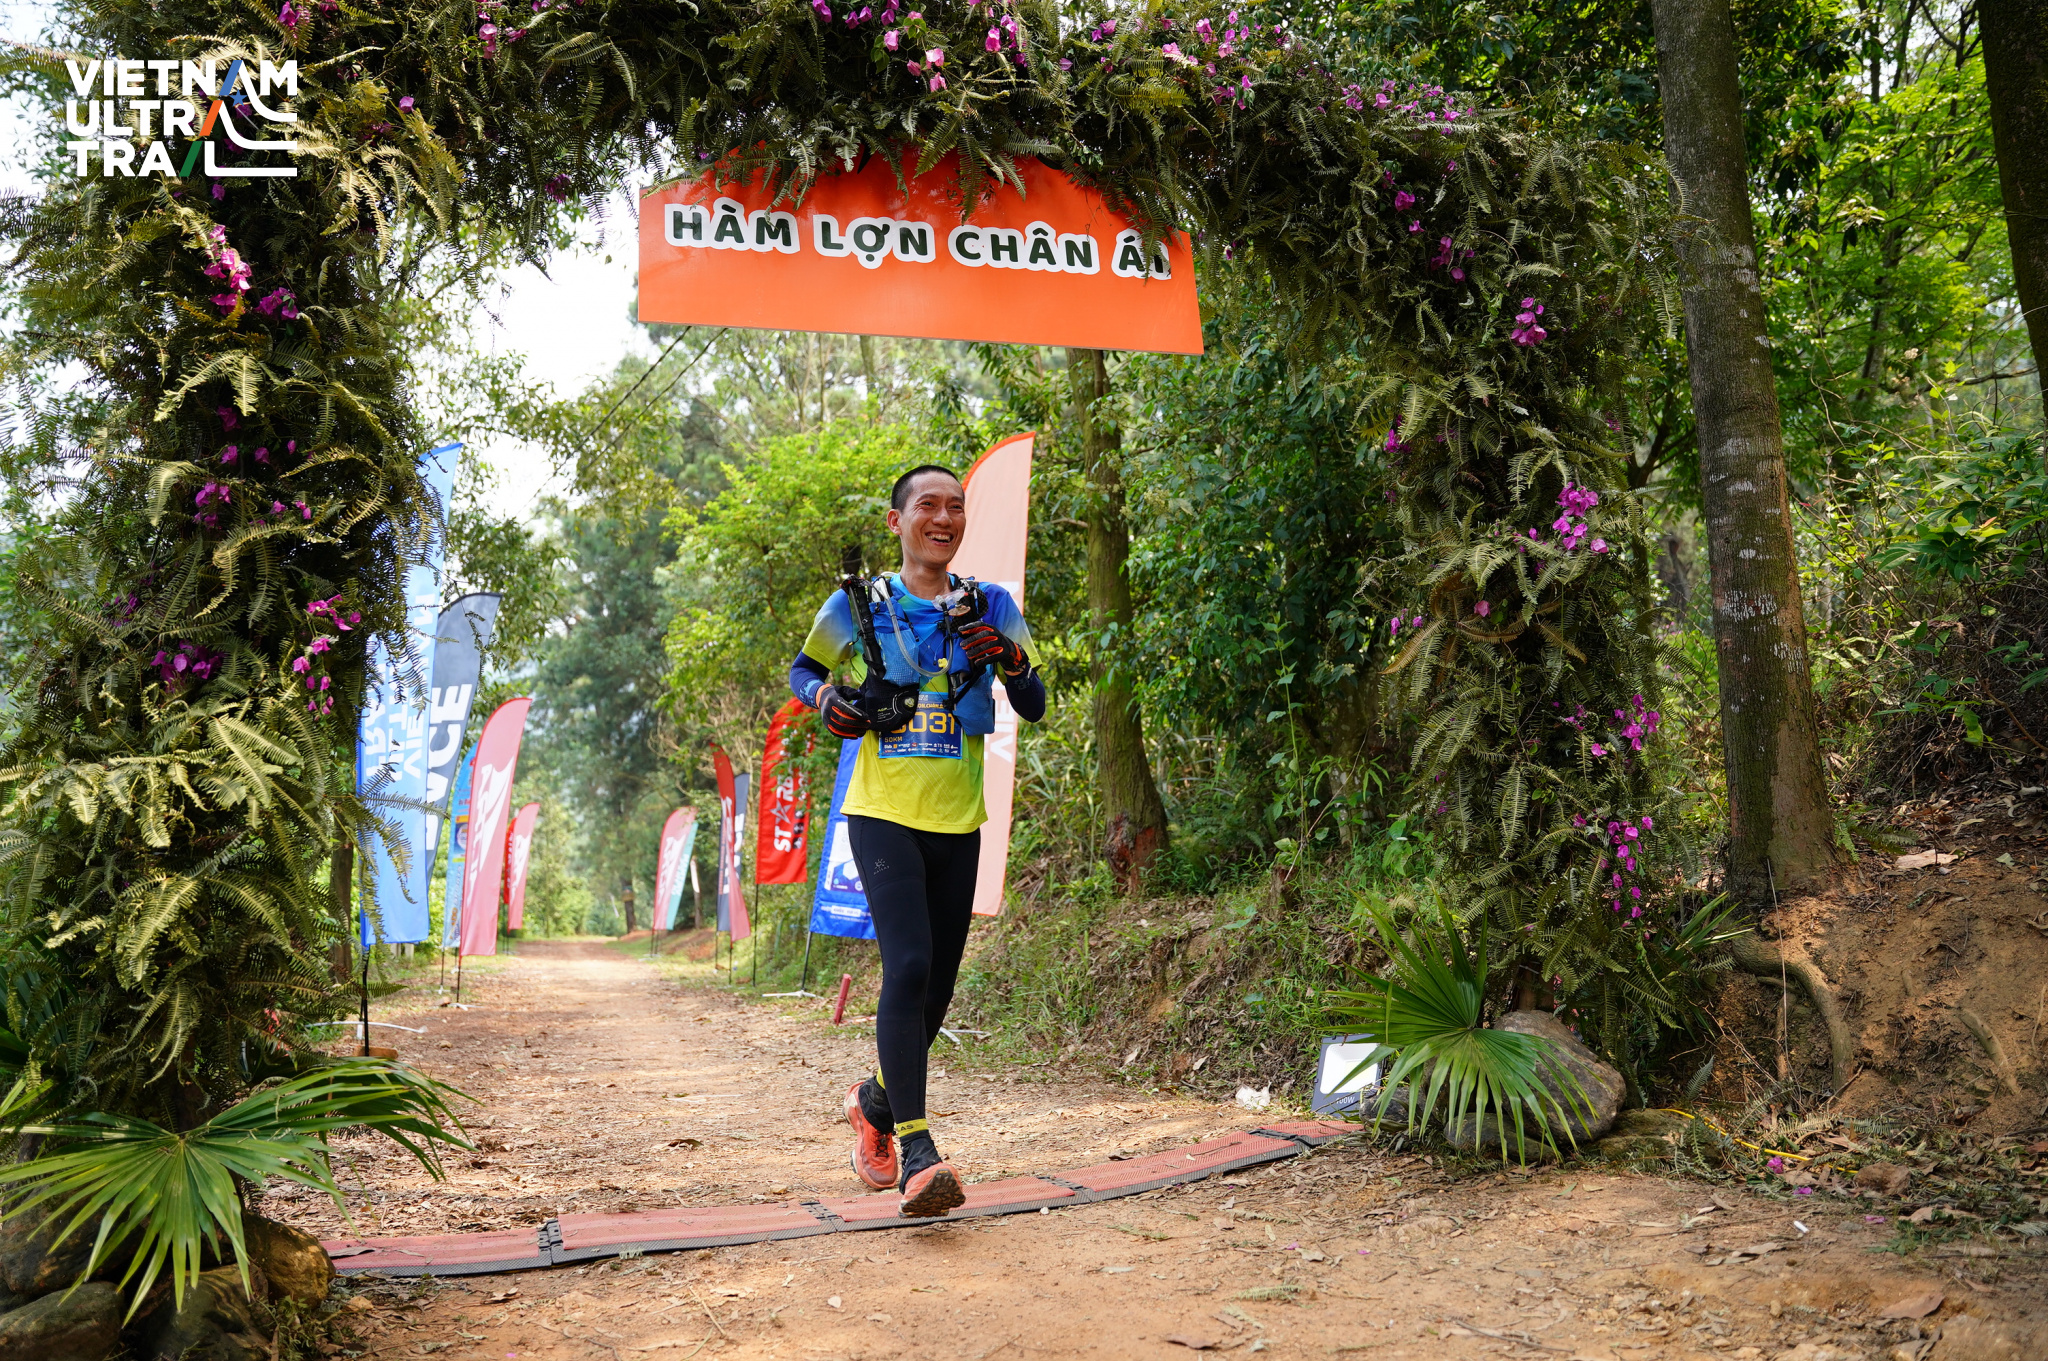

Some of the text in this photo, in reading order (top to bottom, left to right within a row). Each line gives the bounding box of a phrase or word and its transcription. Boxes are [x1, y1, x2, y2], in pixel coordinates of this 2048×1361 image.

[673, 204, 792, 247] HÀM
[821, 221, 928, 262] LỢN
[955, 227, 1093, 268] CHÂN
